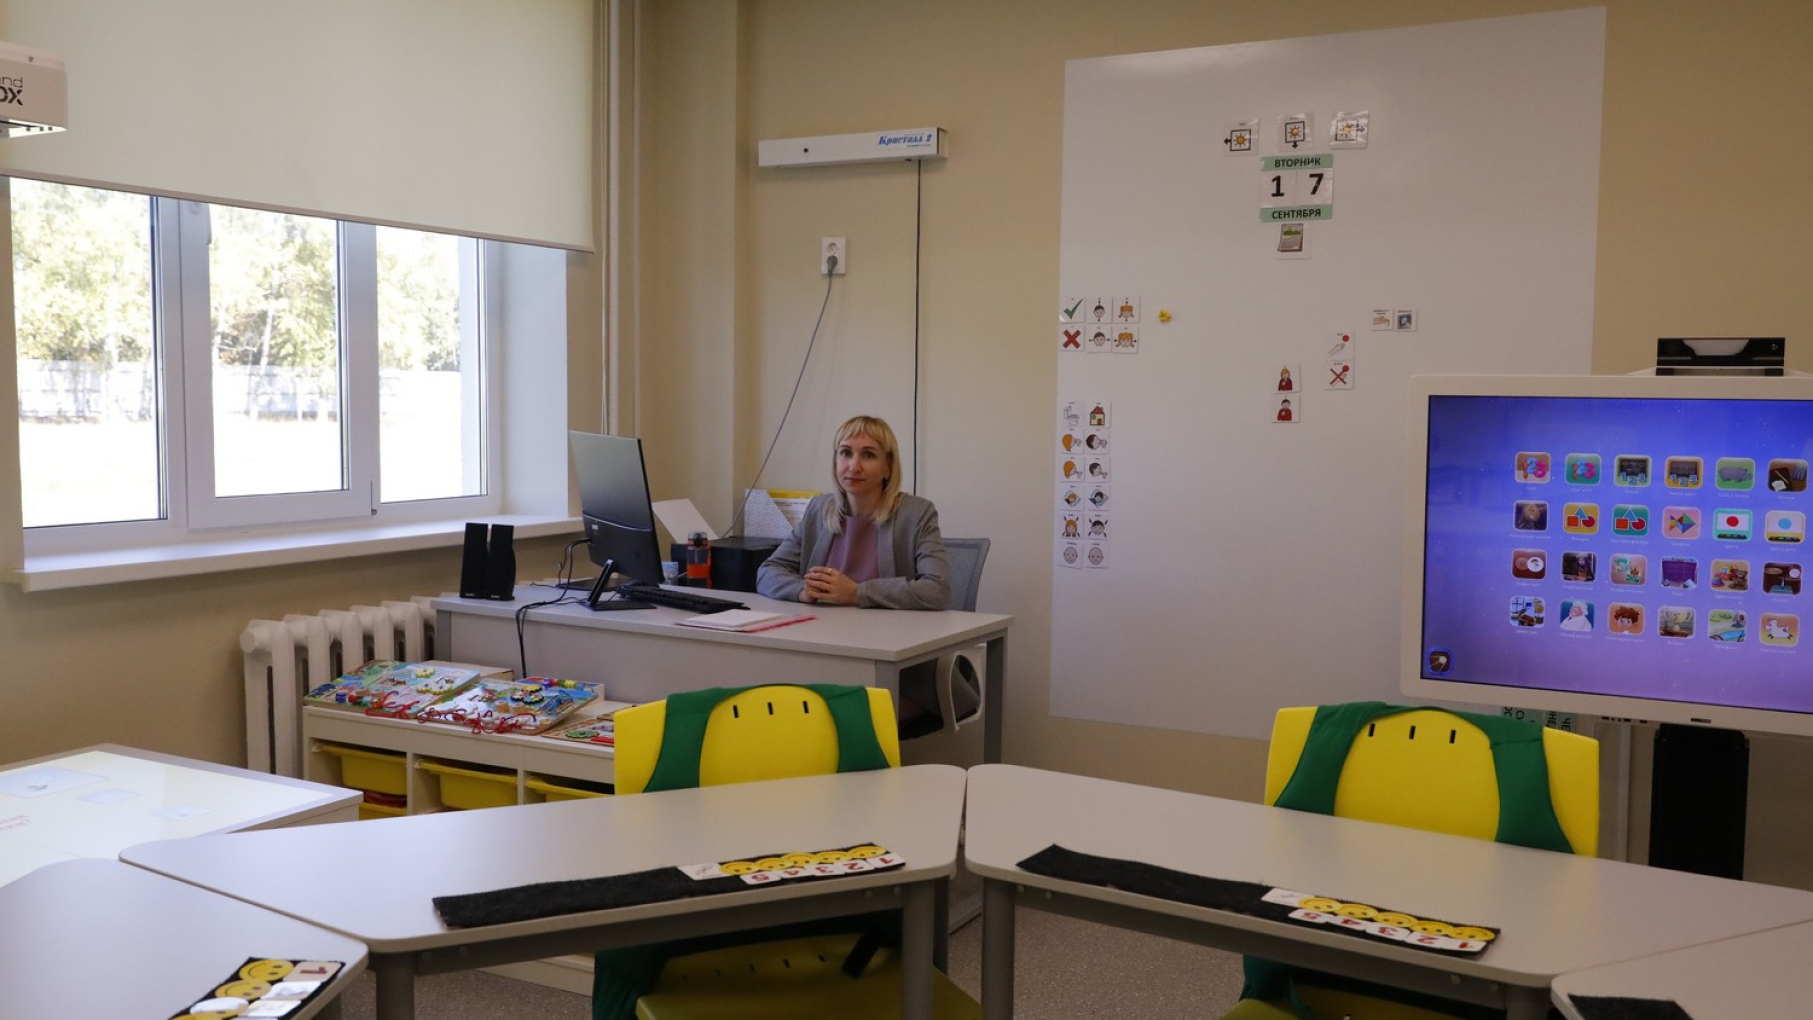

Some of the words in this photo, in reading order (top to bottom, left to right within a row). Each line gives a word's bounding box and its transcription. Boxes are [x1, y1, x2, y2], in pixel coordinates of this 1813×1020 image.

[1274, 156, 1321, 168] ВТОРНИК
[1271, 175, 1285, 198] 1
[1309, 172, 1324, 195] 7
[1271, 208, 1322, 220] СЕНТЯБРЯ
